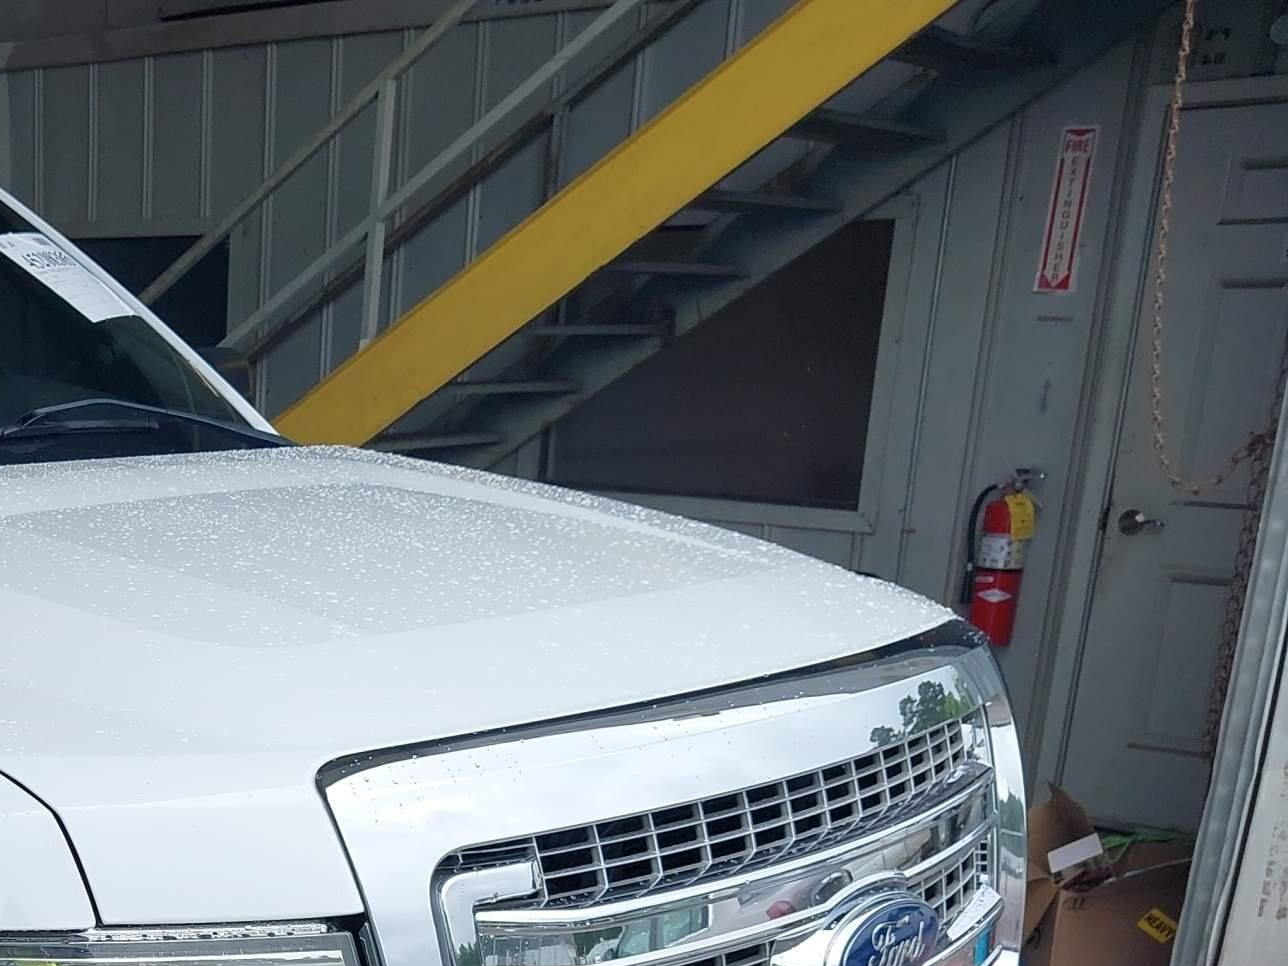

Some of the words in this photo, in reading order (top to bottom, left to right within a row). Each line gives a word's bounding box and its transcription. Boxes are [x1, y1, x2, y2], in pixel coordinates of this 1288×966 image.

[1065, 138, 1090, 153] FIRE
[1051, 156, 1077, 281] EXTINGUISHER
[1143, 912, 1176, 938] HEAVY
